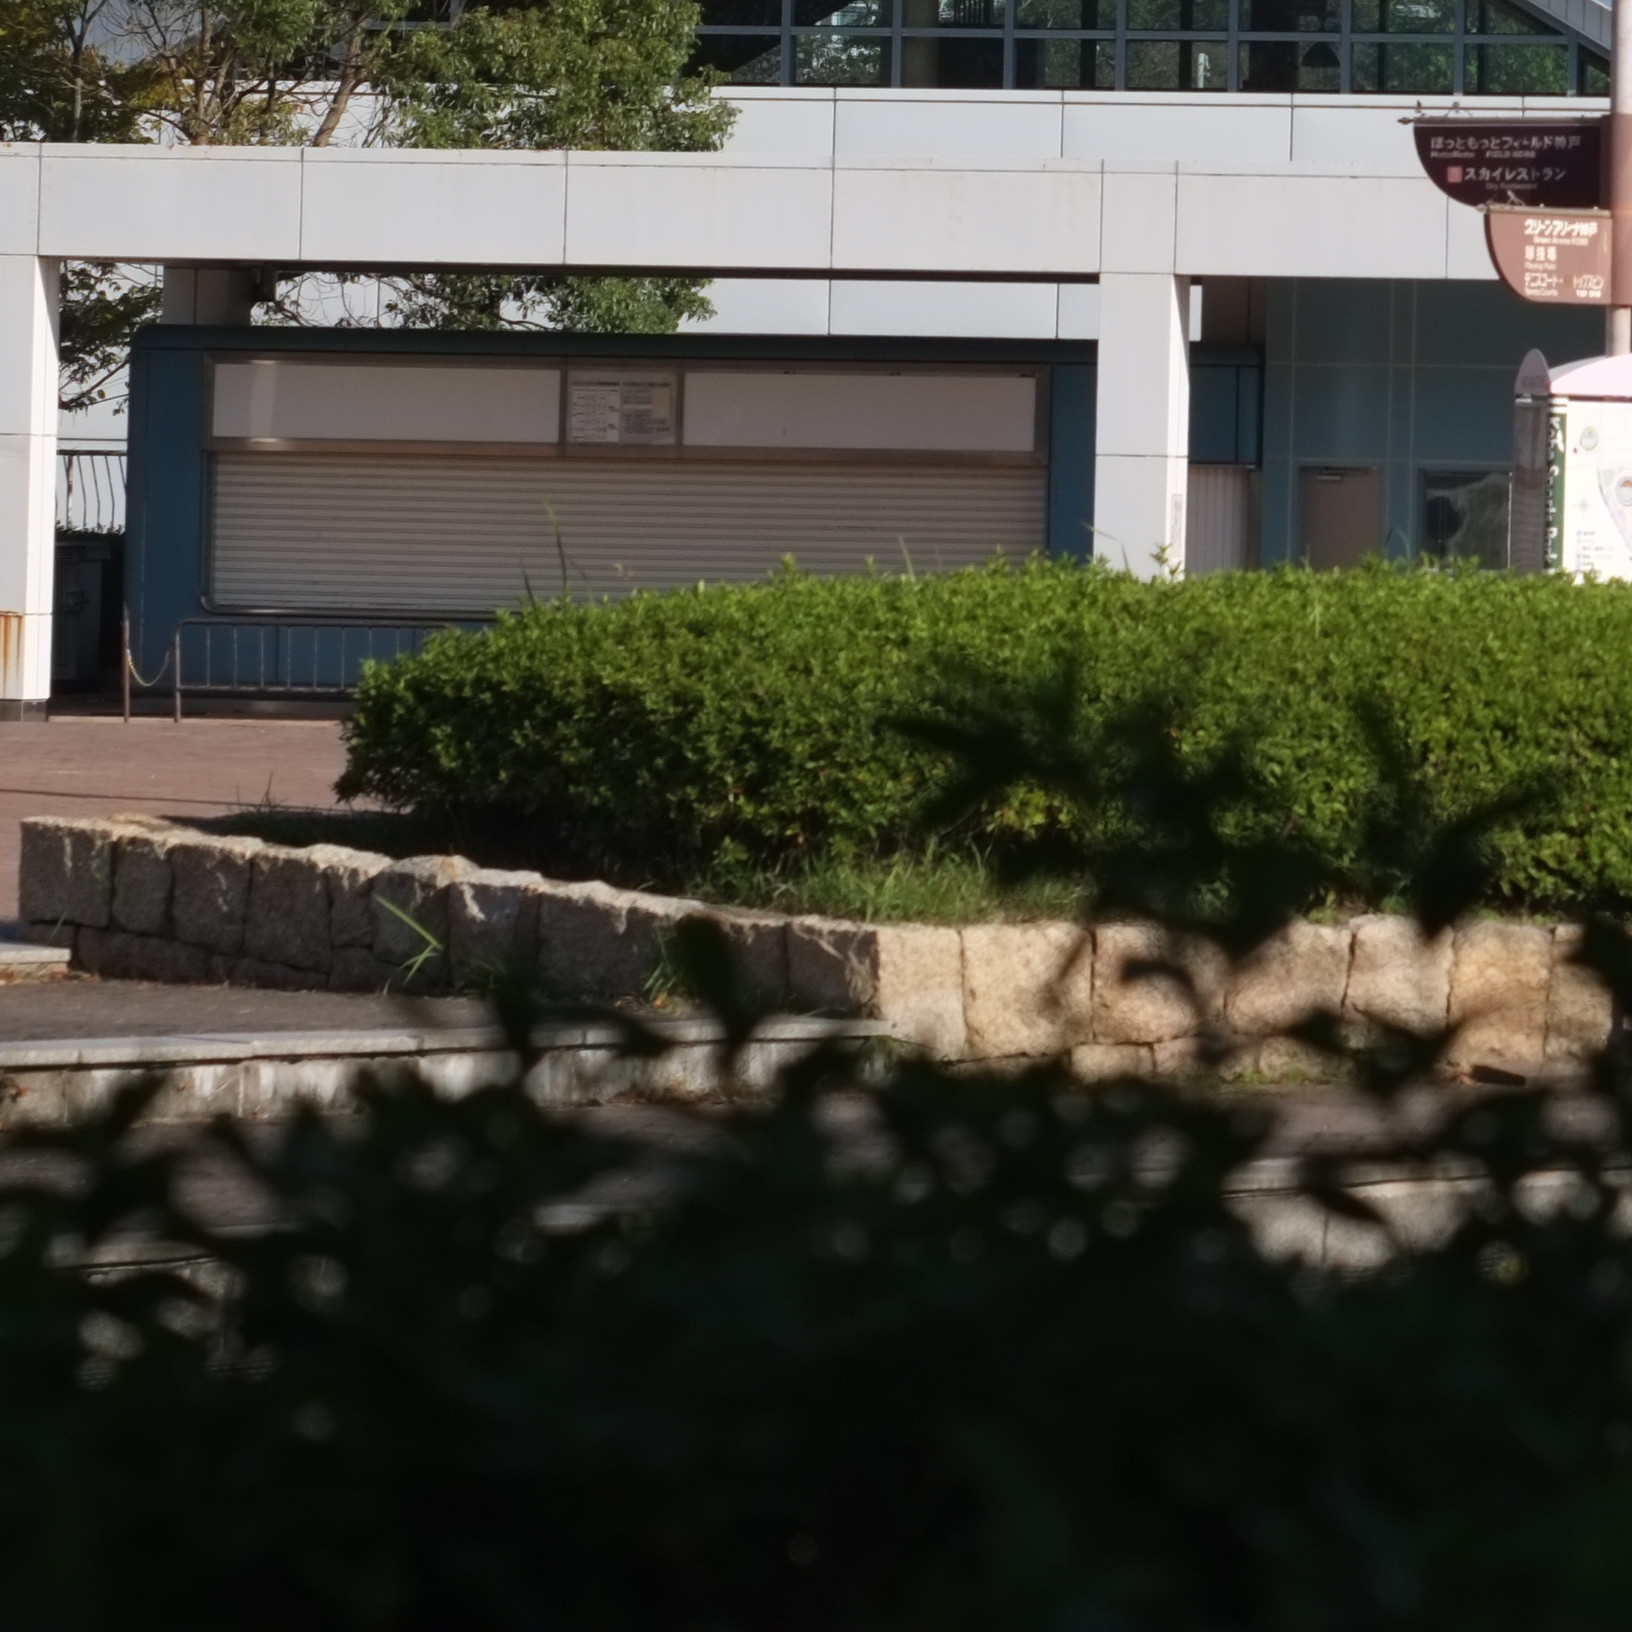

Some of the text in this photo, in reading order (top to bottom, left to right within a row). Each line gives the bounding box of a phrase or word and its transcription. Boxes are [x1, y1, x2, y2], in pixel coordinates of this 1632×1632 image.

[1464, 167, 1567, 182] スカイレストラン
